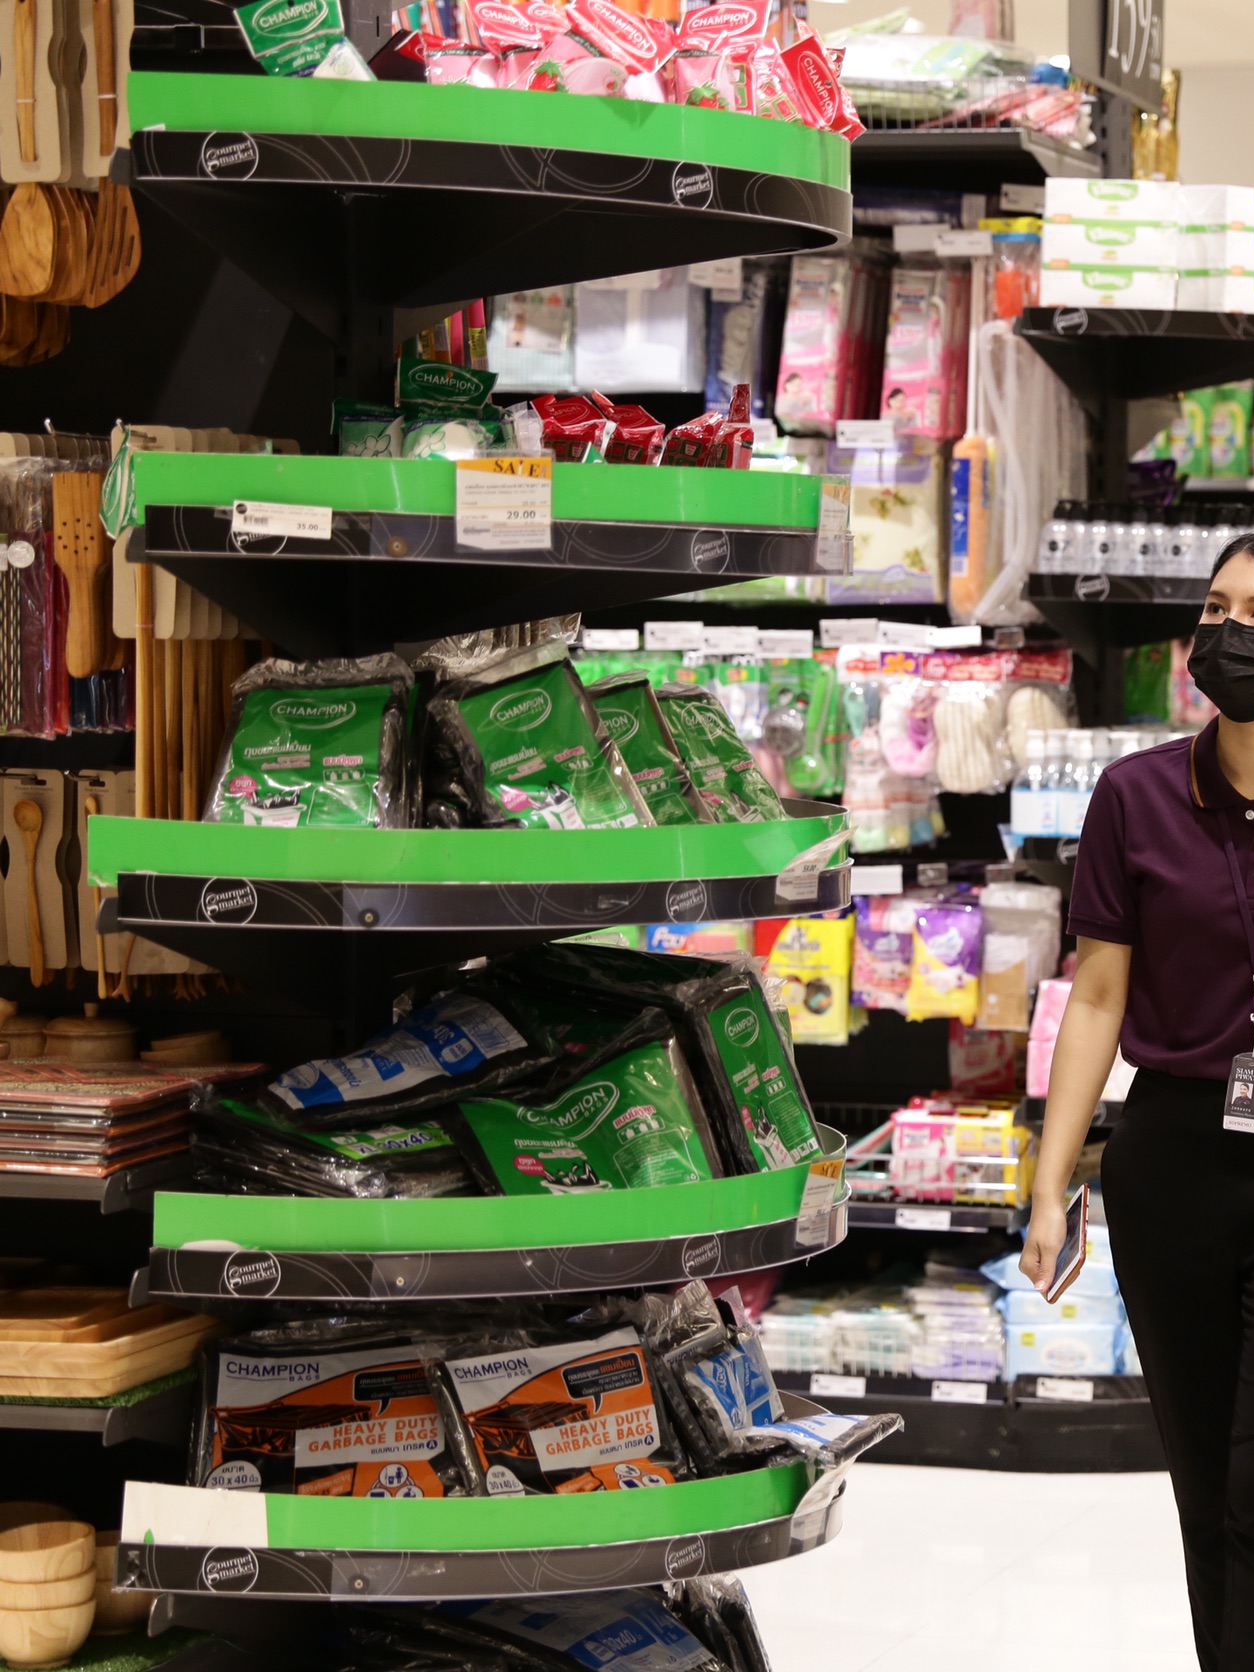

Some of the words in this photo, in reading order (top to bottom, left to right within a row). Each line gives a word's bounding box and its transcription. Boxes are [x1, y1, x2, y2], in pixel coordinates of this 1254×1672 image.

[259, 1, 317, 28] CHAMPION
[481, 8, 532, 28] CHAMPIO
[691, 12, 749, 28] CHAMPION
[593, 3, 650, 49] CHAMPION
[803, 57, 834, 117] CHAMPION
[415, 372, 476, 391] CHAMPION
[506, 510, 536, 520] 29.00
[296, 522, 319, 531] 35.00
[277, 703, 347, 716] CHAMPION
[497, 695, 545, 721] CHAMPION
[604, 715, 628, 729] PION
[728, 1016, 755, 1037] CHAMPION
[1236, 1067, 1254, 1075] SIAM
[226, 1361, 320, 1377] CHAMPION
[454, 1357, 530, 1379] CHAMPION
[507, 1368, 533, 1379] BAGS
[289, 1374, 320, 1382] BAGS
[333, 1421, 387, 1438] HEAVY
[395, 1416, 438, 1430] DUTY
[559, 1420, 608, 1439] HEAVY
[616, 1409, 651, 1427] DUTY
[308, 1434, 387, 1452] GARBAGE
[394, 1428, 438, 1443] BAGS
[546, 1433, 611, 1455] GARBAGE
[617, 1422, 653, 1440] BAGS
[212, 1476, 224, 1486] 30
[234, 1475, 247, 1484] 40
[489, 1481, 498, 1490] 30
[504, 1480, 512, 1489] 40
